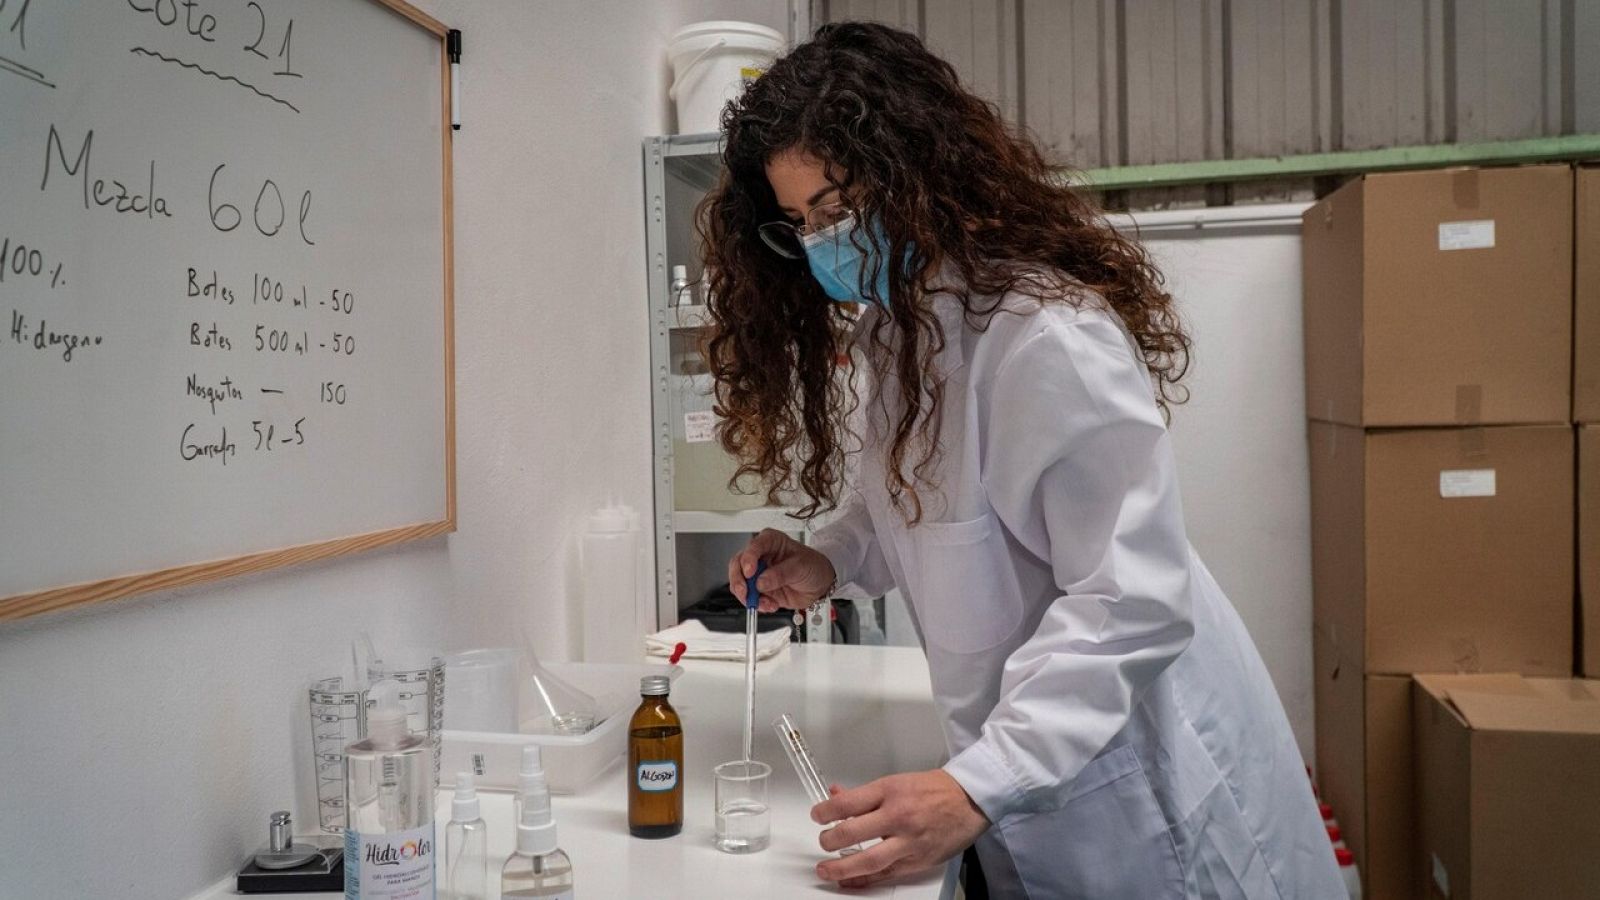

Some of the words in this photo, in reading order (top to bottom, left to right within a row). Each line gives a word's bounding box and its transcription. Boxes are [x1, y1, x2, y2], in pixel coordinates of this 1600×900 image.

[243, 2, 304, 78] 21
[41, 124, 172, 218] Mezcla
[188, 267, 235, 305] Botes
[191, 321, 232, 351] Botes
[320, 382, 346, 405] 150
